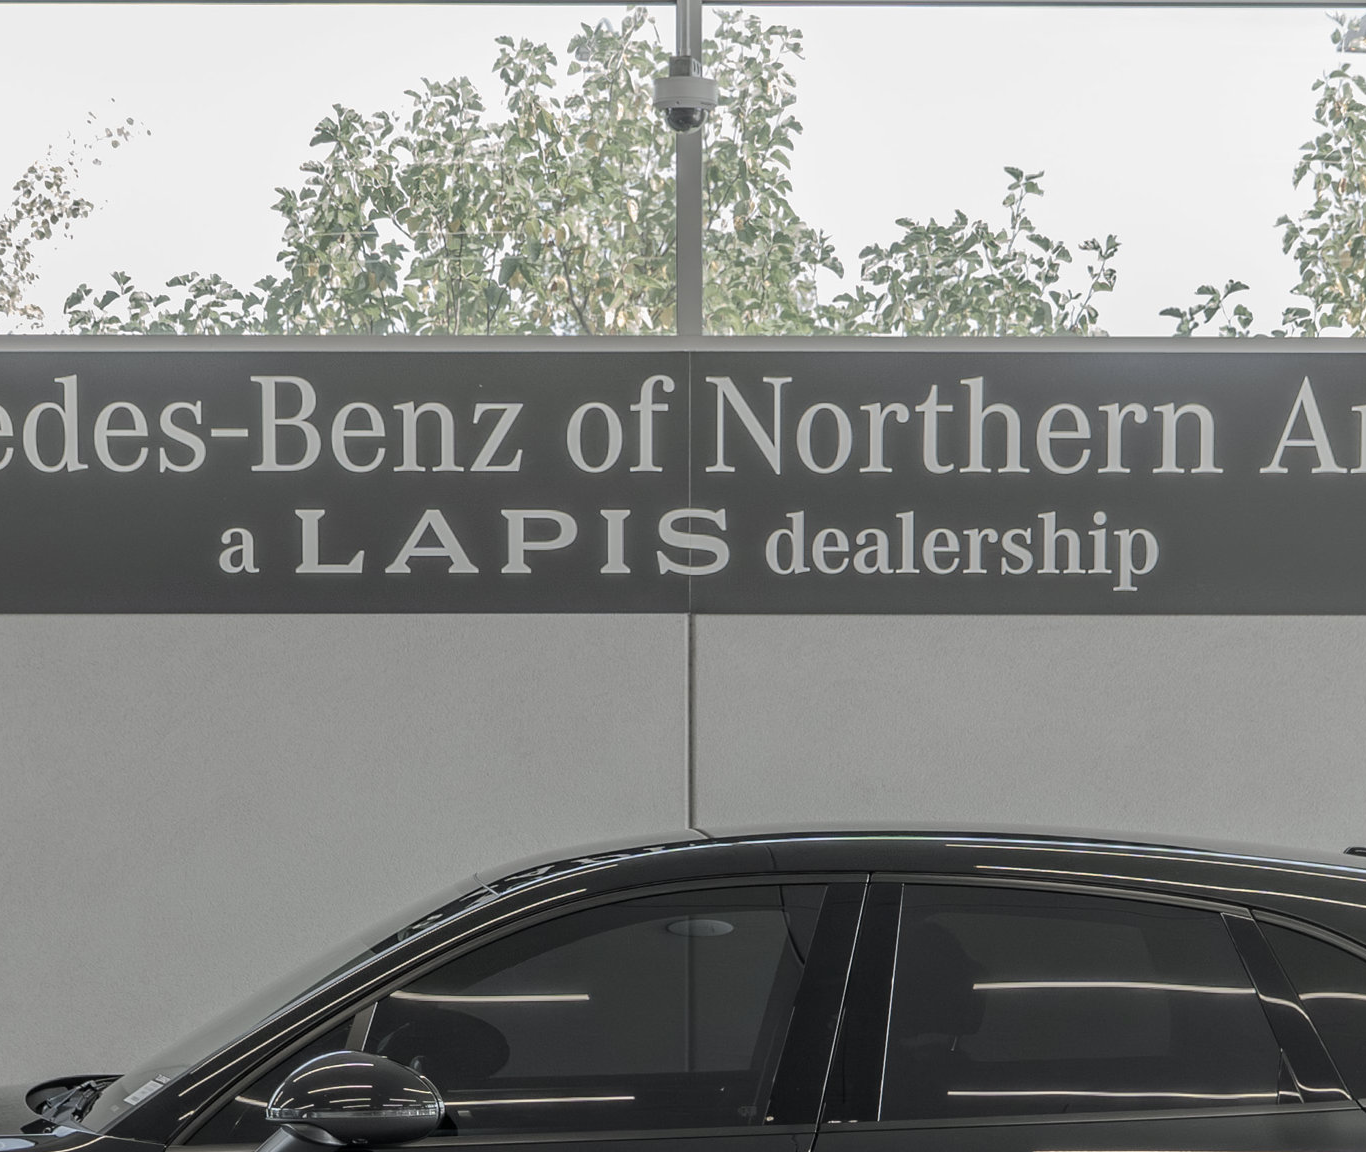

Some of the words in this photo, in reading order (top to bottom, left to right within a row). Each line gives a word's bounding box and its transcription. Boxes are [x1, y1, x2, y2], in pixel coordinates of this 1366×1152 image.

[566, 373, 676, 474] of
[705, 375, 1224, 476] Northern
[218, 527, 260, 574] a
[294, 508, 730, 576] LAPIS
[765, 510, 1160, 592] dealership
